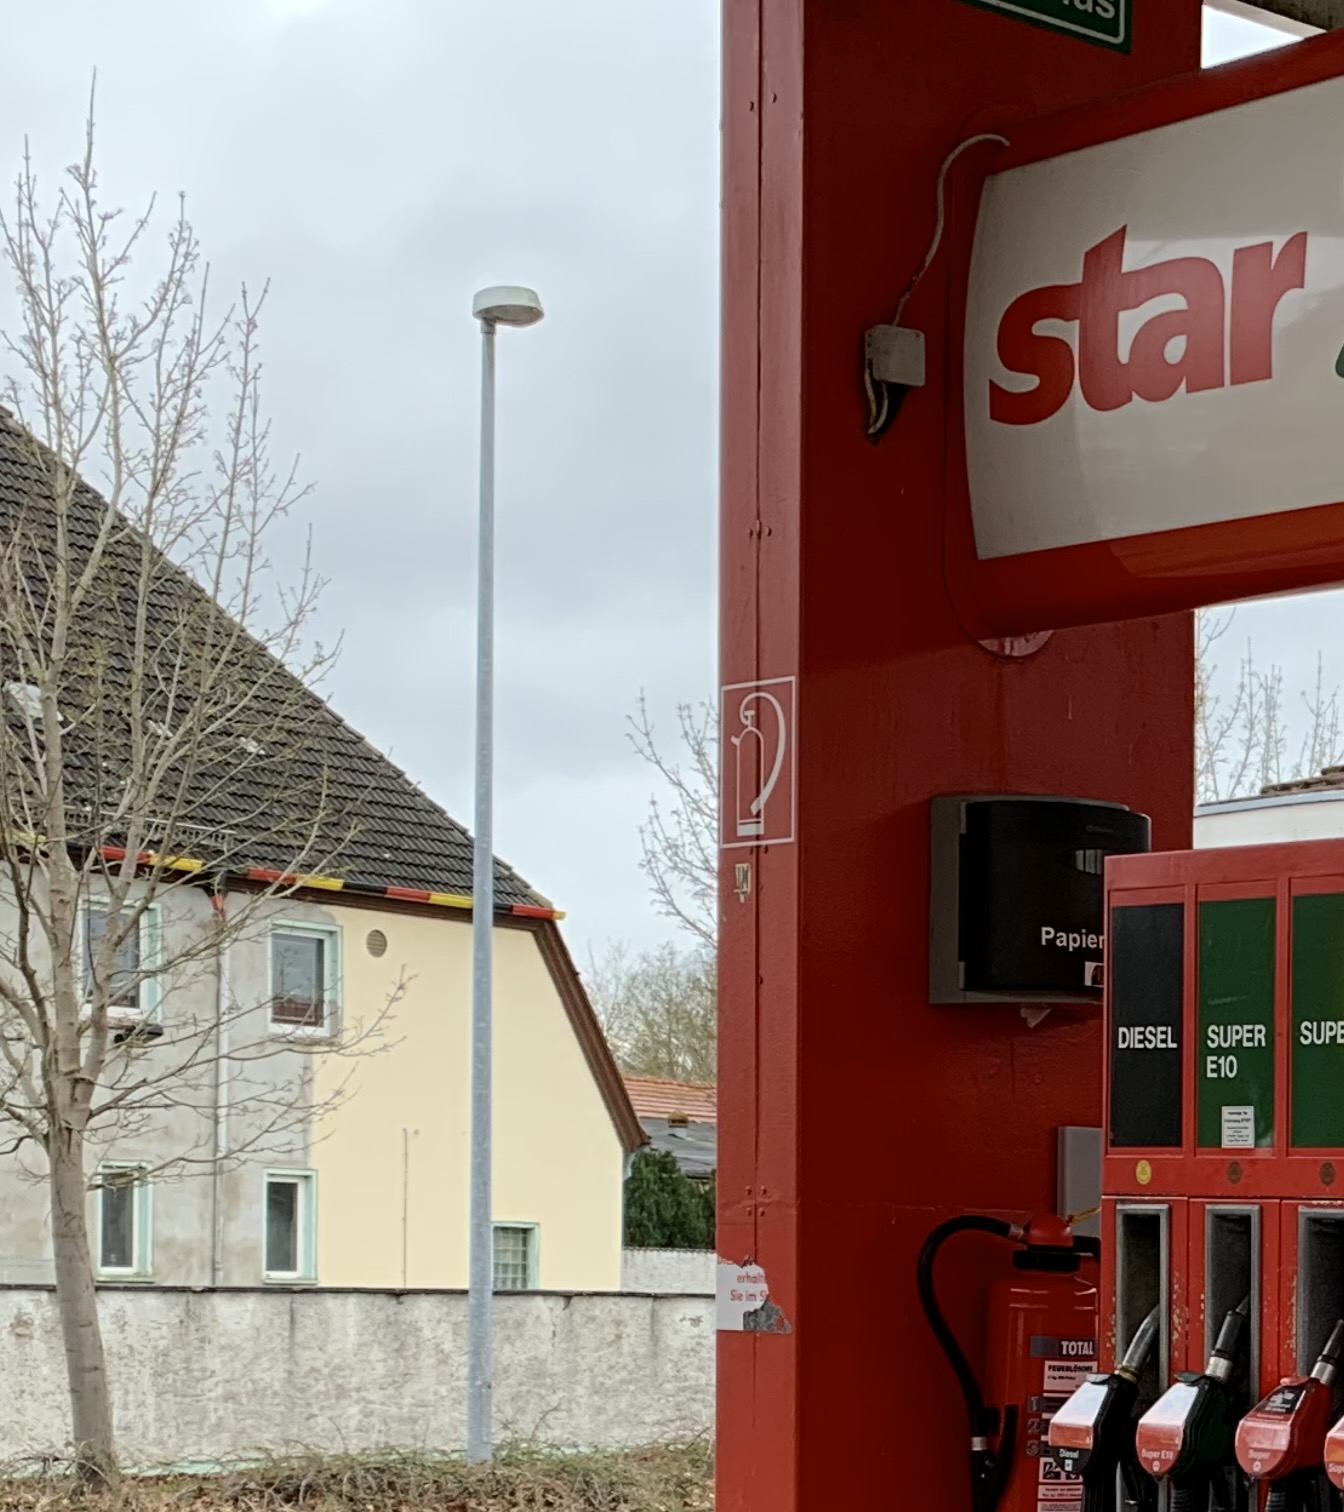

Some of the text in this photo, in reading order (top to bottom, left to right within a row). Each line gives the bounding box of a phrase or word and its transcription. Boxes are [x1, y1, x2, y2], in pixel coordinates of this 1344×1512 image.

[988, 224, 1308, 426] star
[1118, 1026, 1177, 1049] DIESEL
[1207, 1024, 1266, 1048] SUPER
[1206, 1055, 1238, 1078] E10
[1061, 1341, 1094, 1355] TOTAL
[1059, 1449, 1079, 1459] Diesel
[1141, 1449, 1161, 1460] Super
[1248, 1449, 1270, 1460] Super
